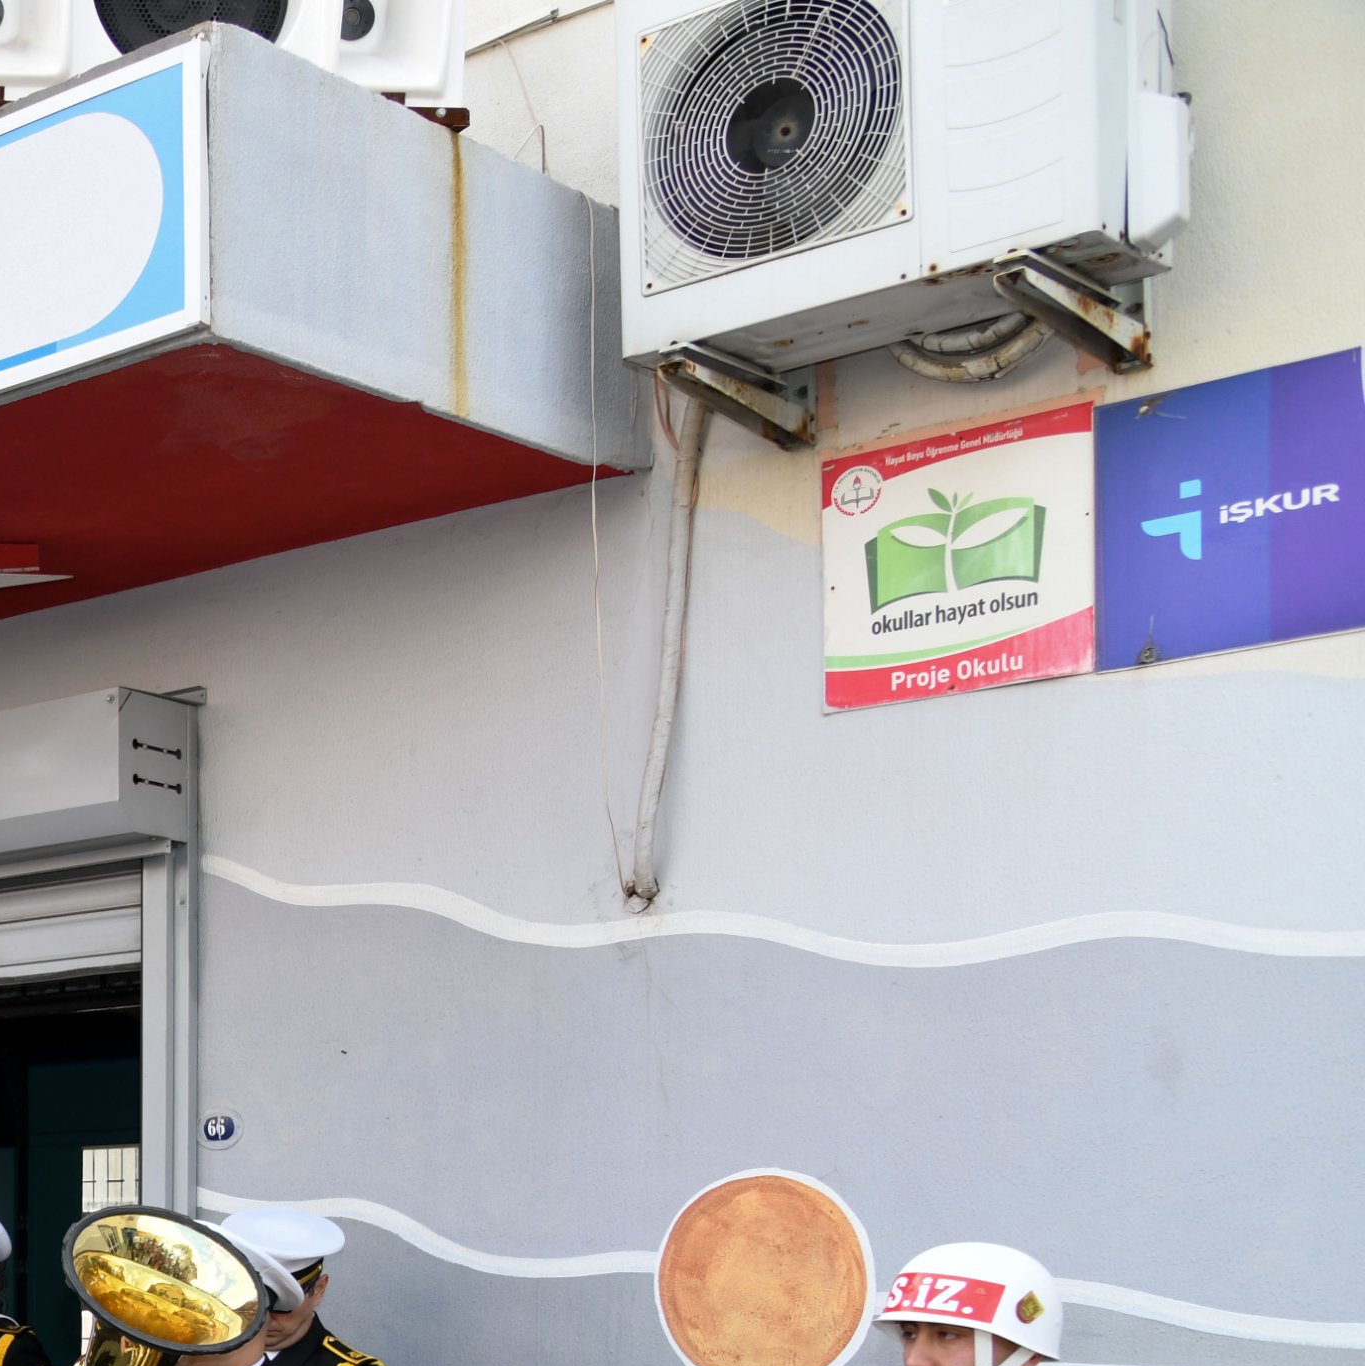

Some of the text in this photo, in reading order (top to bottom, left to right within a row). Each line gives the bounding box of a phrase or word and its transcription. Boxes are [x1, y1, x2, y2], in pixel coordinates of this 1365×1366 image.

[885, 454, 905, 466] Hayat
[906, 451, 924, 461] Boyu
[926, 443, 959, 458] Öğrenme
[960, 436, 981, 449] Genel
[872, 592, 1039, 635] okullar hayat olsun
[891, 653, 1023, 691] Proje Okulu
[208, 1119, 225, 1136] 66
